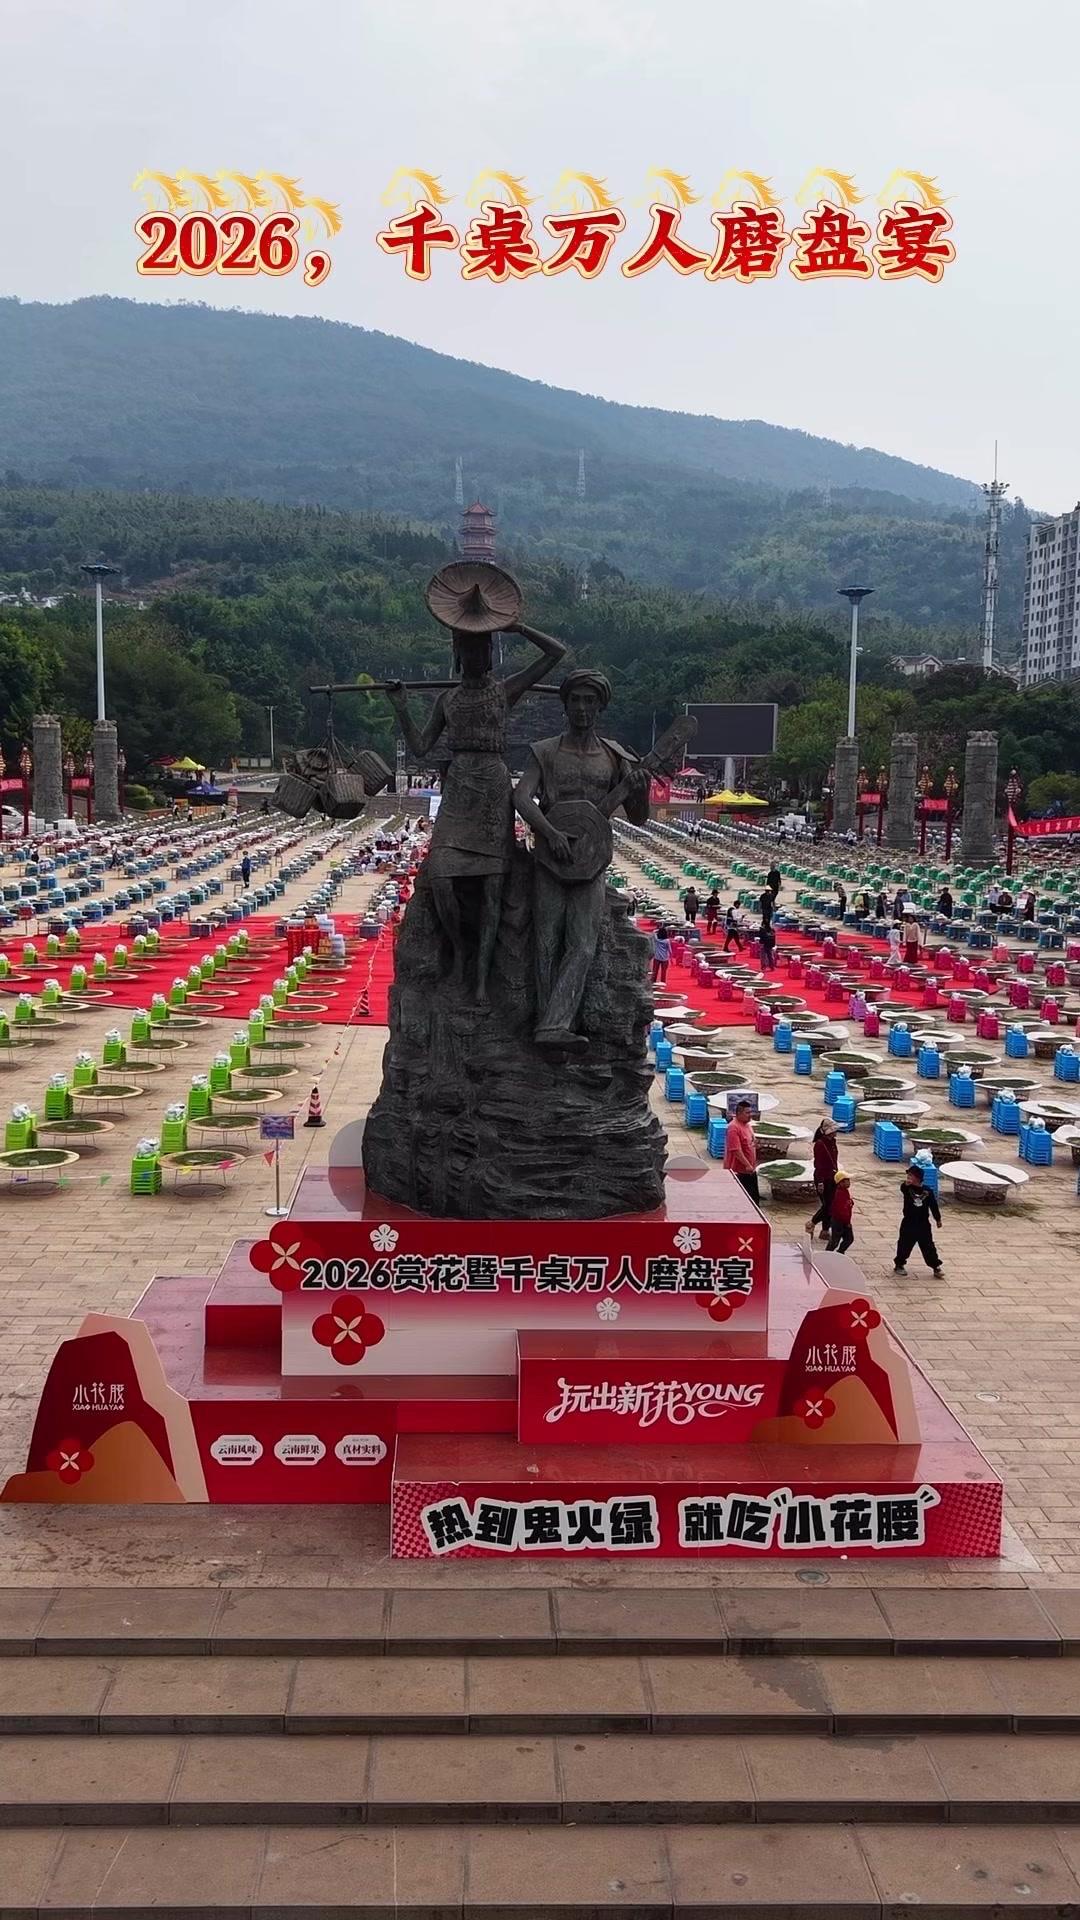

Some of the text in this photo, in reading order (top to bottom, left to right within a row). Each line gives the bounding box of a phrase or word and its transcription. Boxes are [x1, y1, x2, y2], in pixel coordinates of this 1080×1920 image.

[300, 1254, 754, 1295] 2026赏花暨千桌万人磨盘宴
[427, 1499, 656, 1548] 热到鬼火绿
